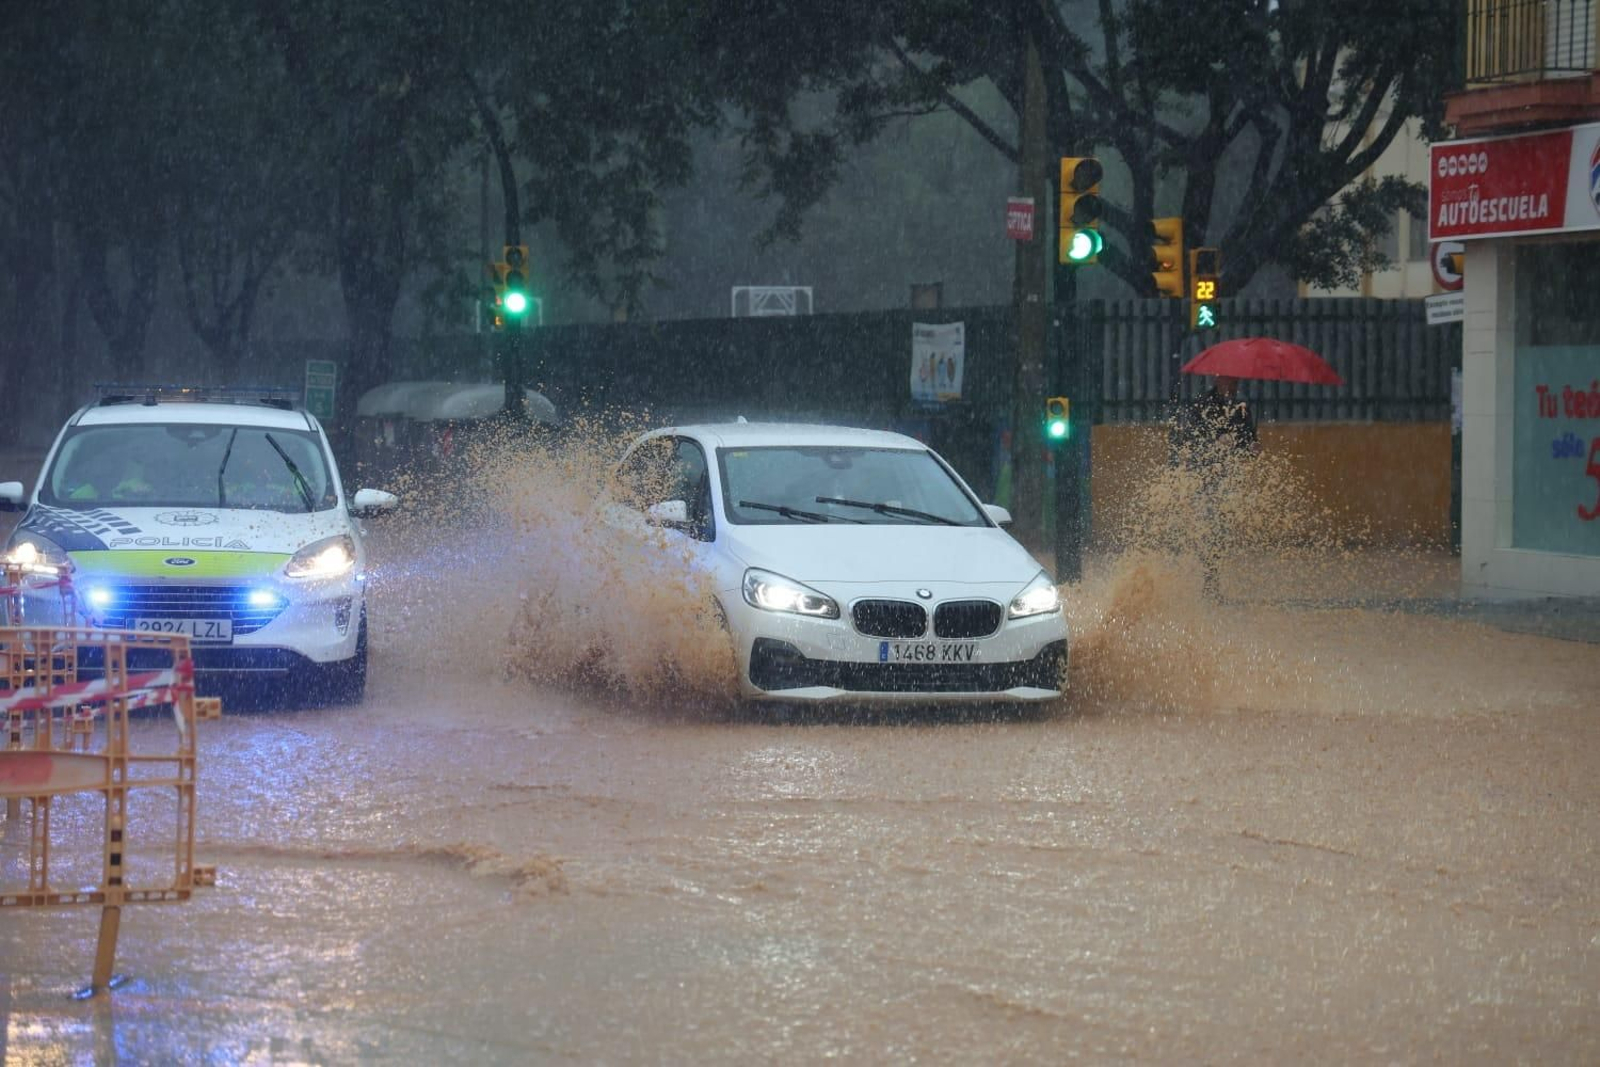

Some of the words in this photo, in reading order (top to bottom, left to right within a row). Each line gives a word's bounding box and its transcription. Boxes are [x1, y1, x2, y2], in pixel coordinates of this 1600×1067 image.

[1437, 192, 1549, 228] AUTOESCUELA
[1197, 281, 1214, 299] 22
[1536, 384, 1558, 419] Tu
[110, 536, 252, 550] POLICÍA
[193, 621, 227, 638] LZL
[894, 644, 936, 661] 1468
[942, 644, 975, 661] KKV
